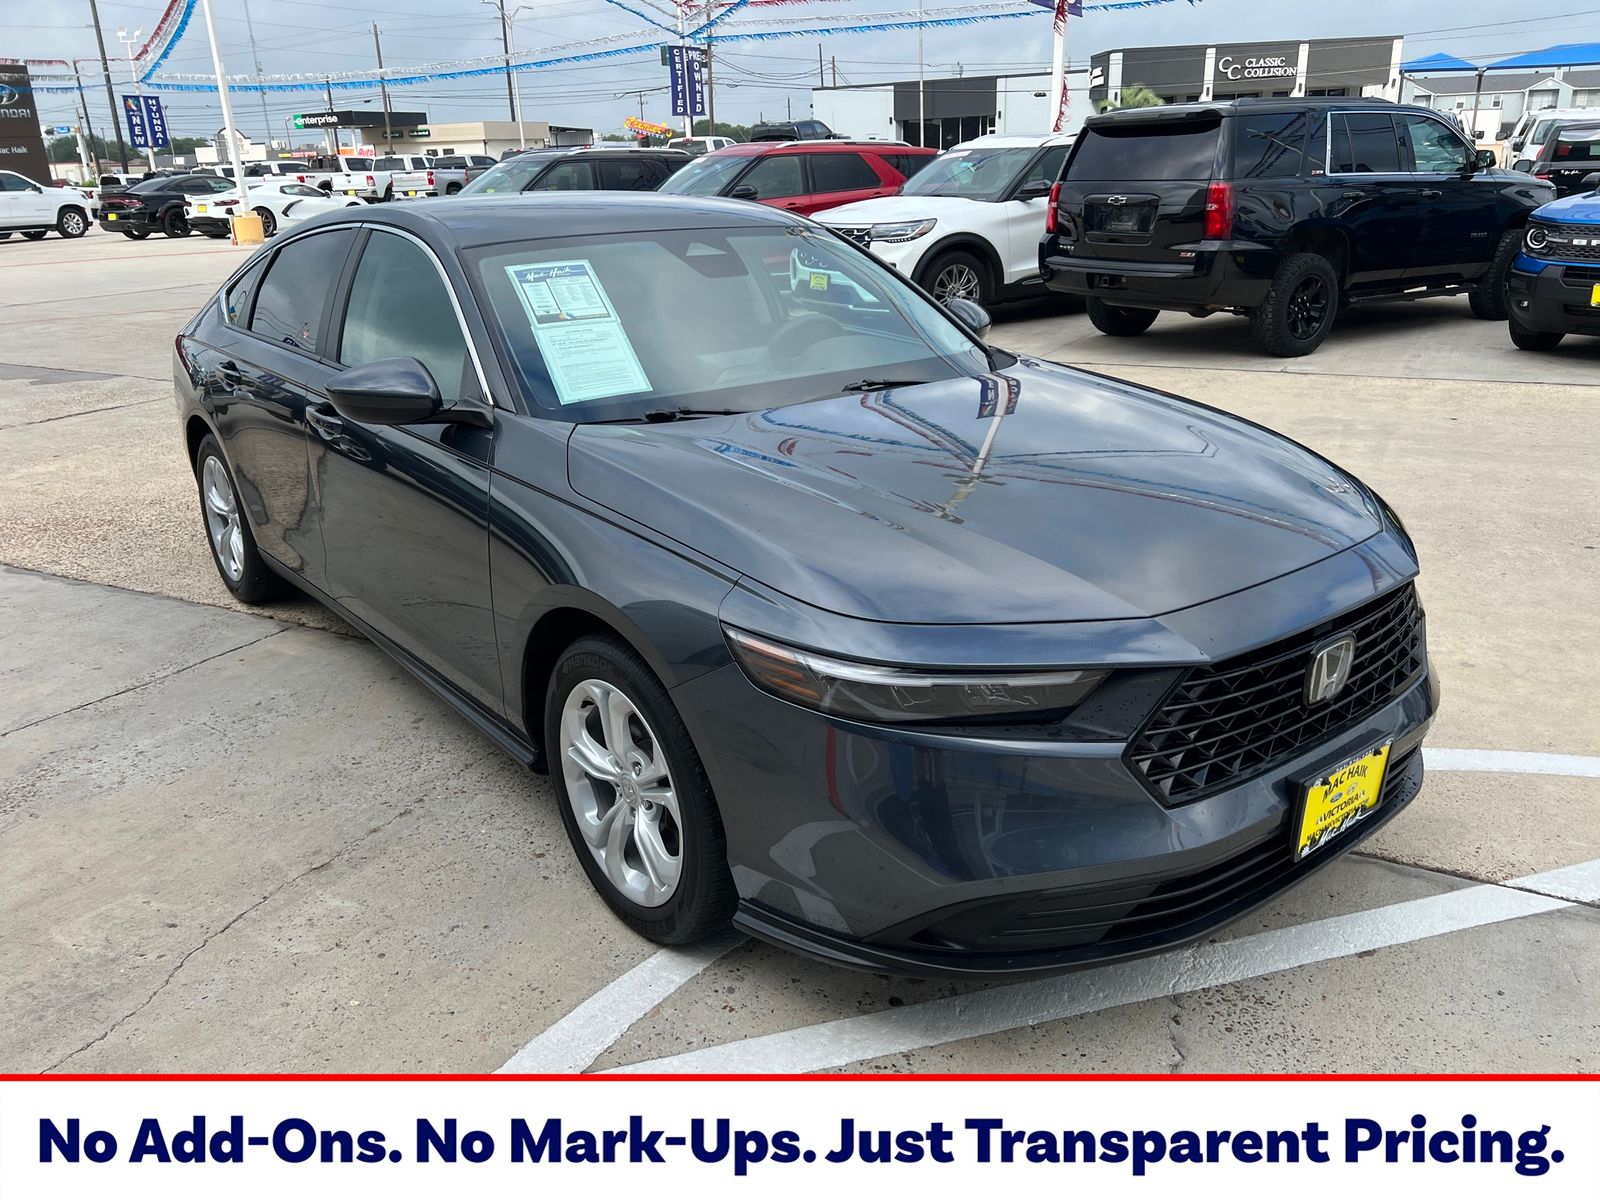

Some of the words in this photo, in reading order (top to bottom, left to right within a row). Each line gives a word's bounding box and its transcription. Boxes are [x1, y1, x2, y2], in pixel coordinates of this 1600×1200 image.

[1244, 67, 1297, 77] COLLISION
[1245, 57, 1285, 67] CLASSIC
[673, 49, 684, 113] CERTIFIED
[693, 61, 702, 112] OWNED
[131, 115, 145, 145] NEW
[148, 99, 164, 145] HYUNDAI
[294, 115, 338, 126] enterprise
[526, 270, 548, 282] Mac
[1322, 771, 1345, 803] MAC
[1346, 764, 1369, 780] HAIK
[1321, 794, 1360, 823] VICTORIA
